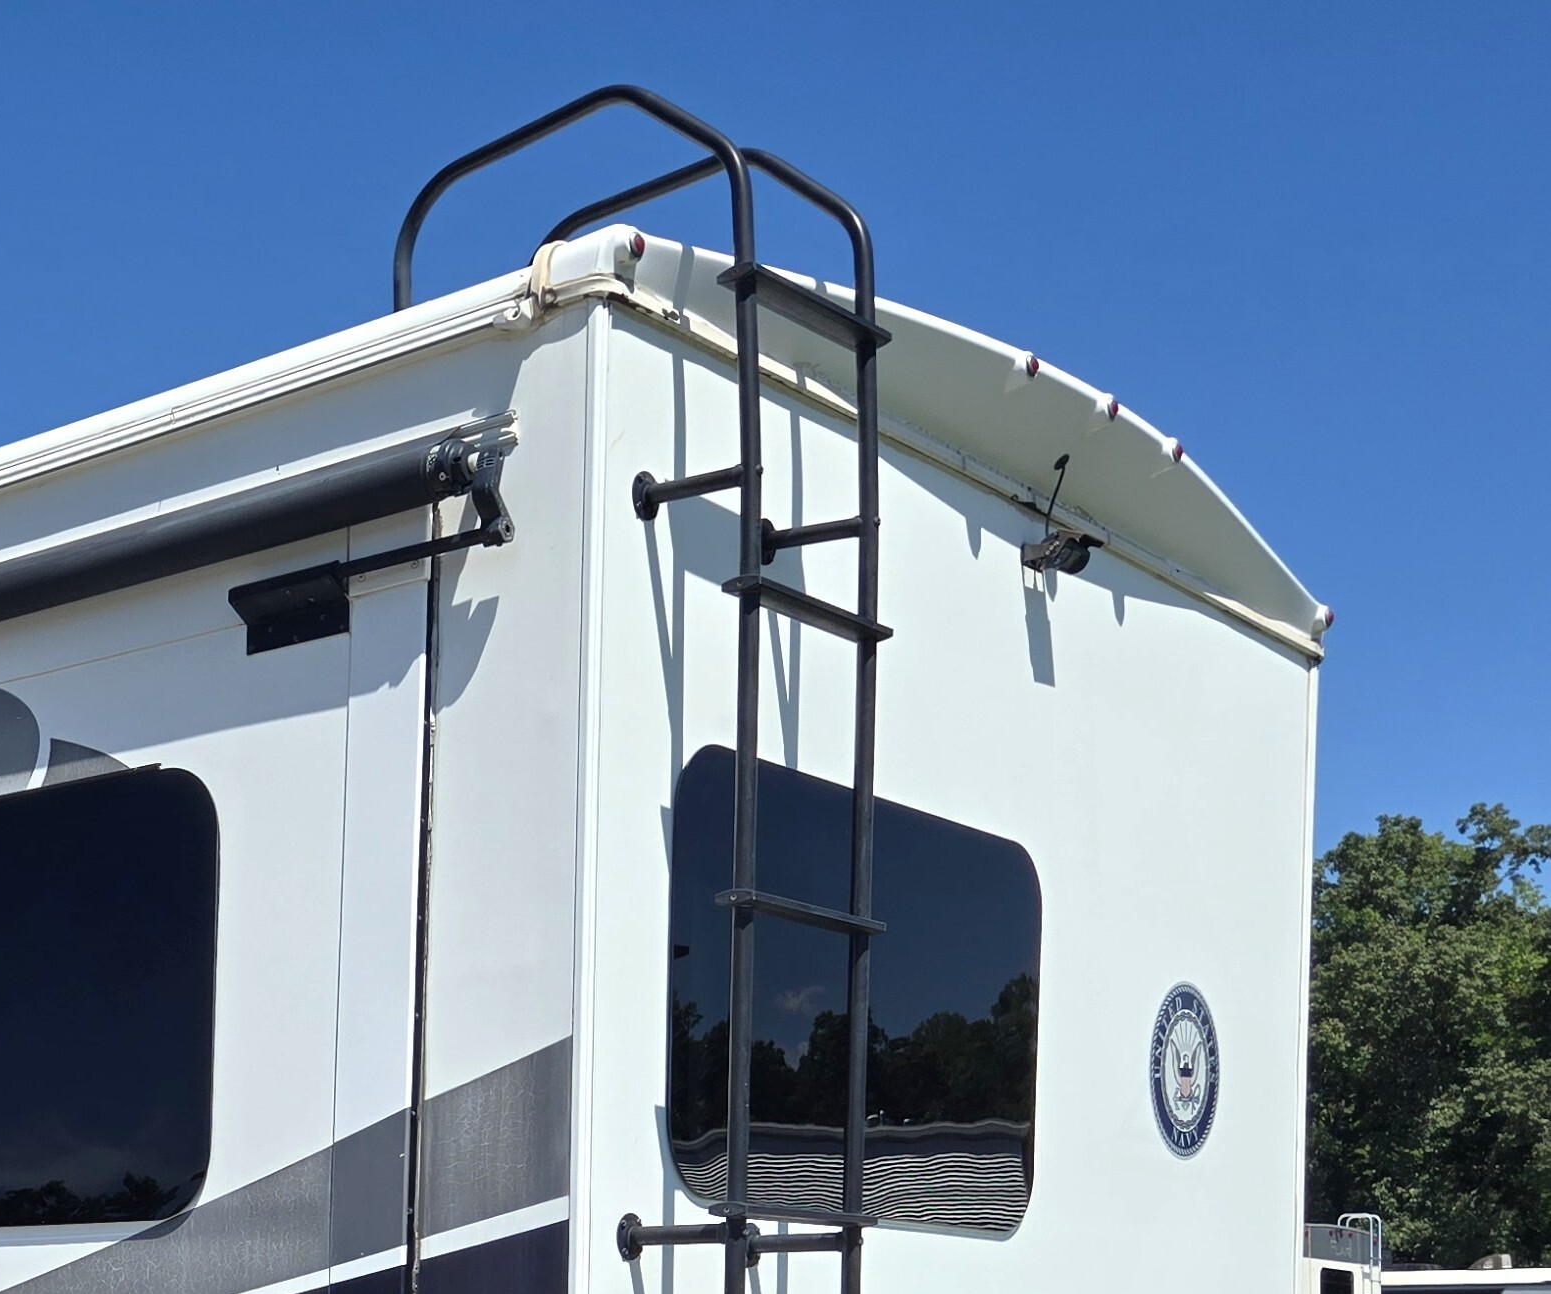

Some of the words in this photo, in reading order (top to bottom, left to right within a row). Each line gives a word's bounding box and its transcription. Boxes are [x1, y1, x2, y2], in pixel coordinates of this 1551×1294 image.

[1154, 996, 1182, 1079] UNITED
[1192, 999, 1217, 1083] STATES
[1171, 1125, 1199, 1148] NAVY
